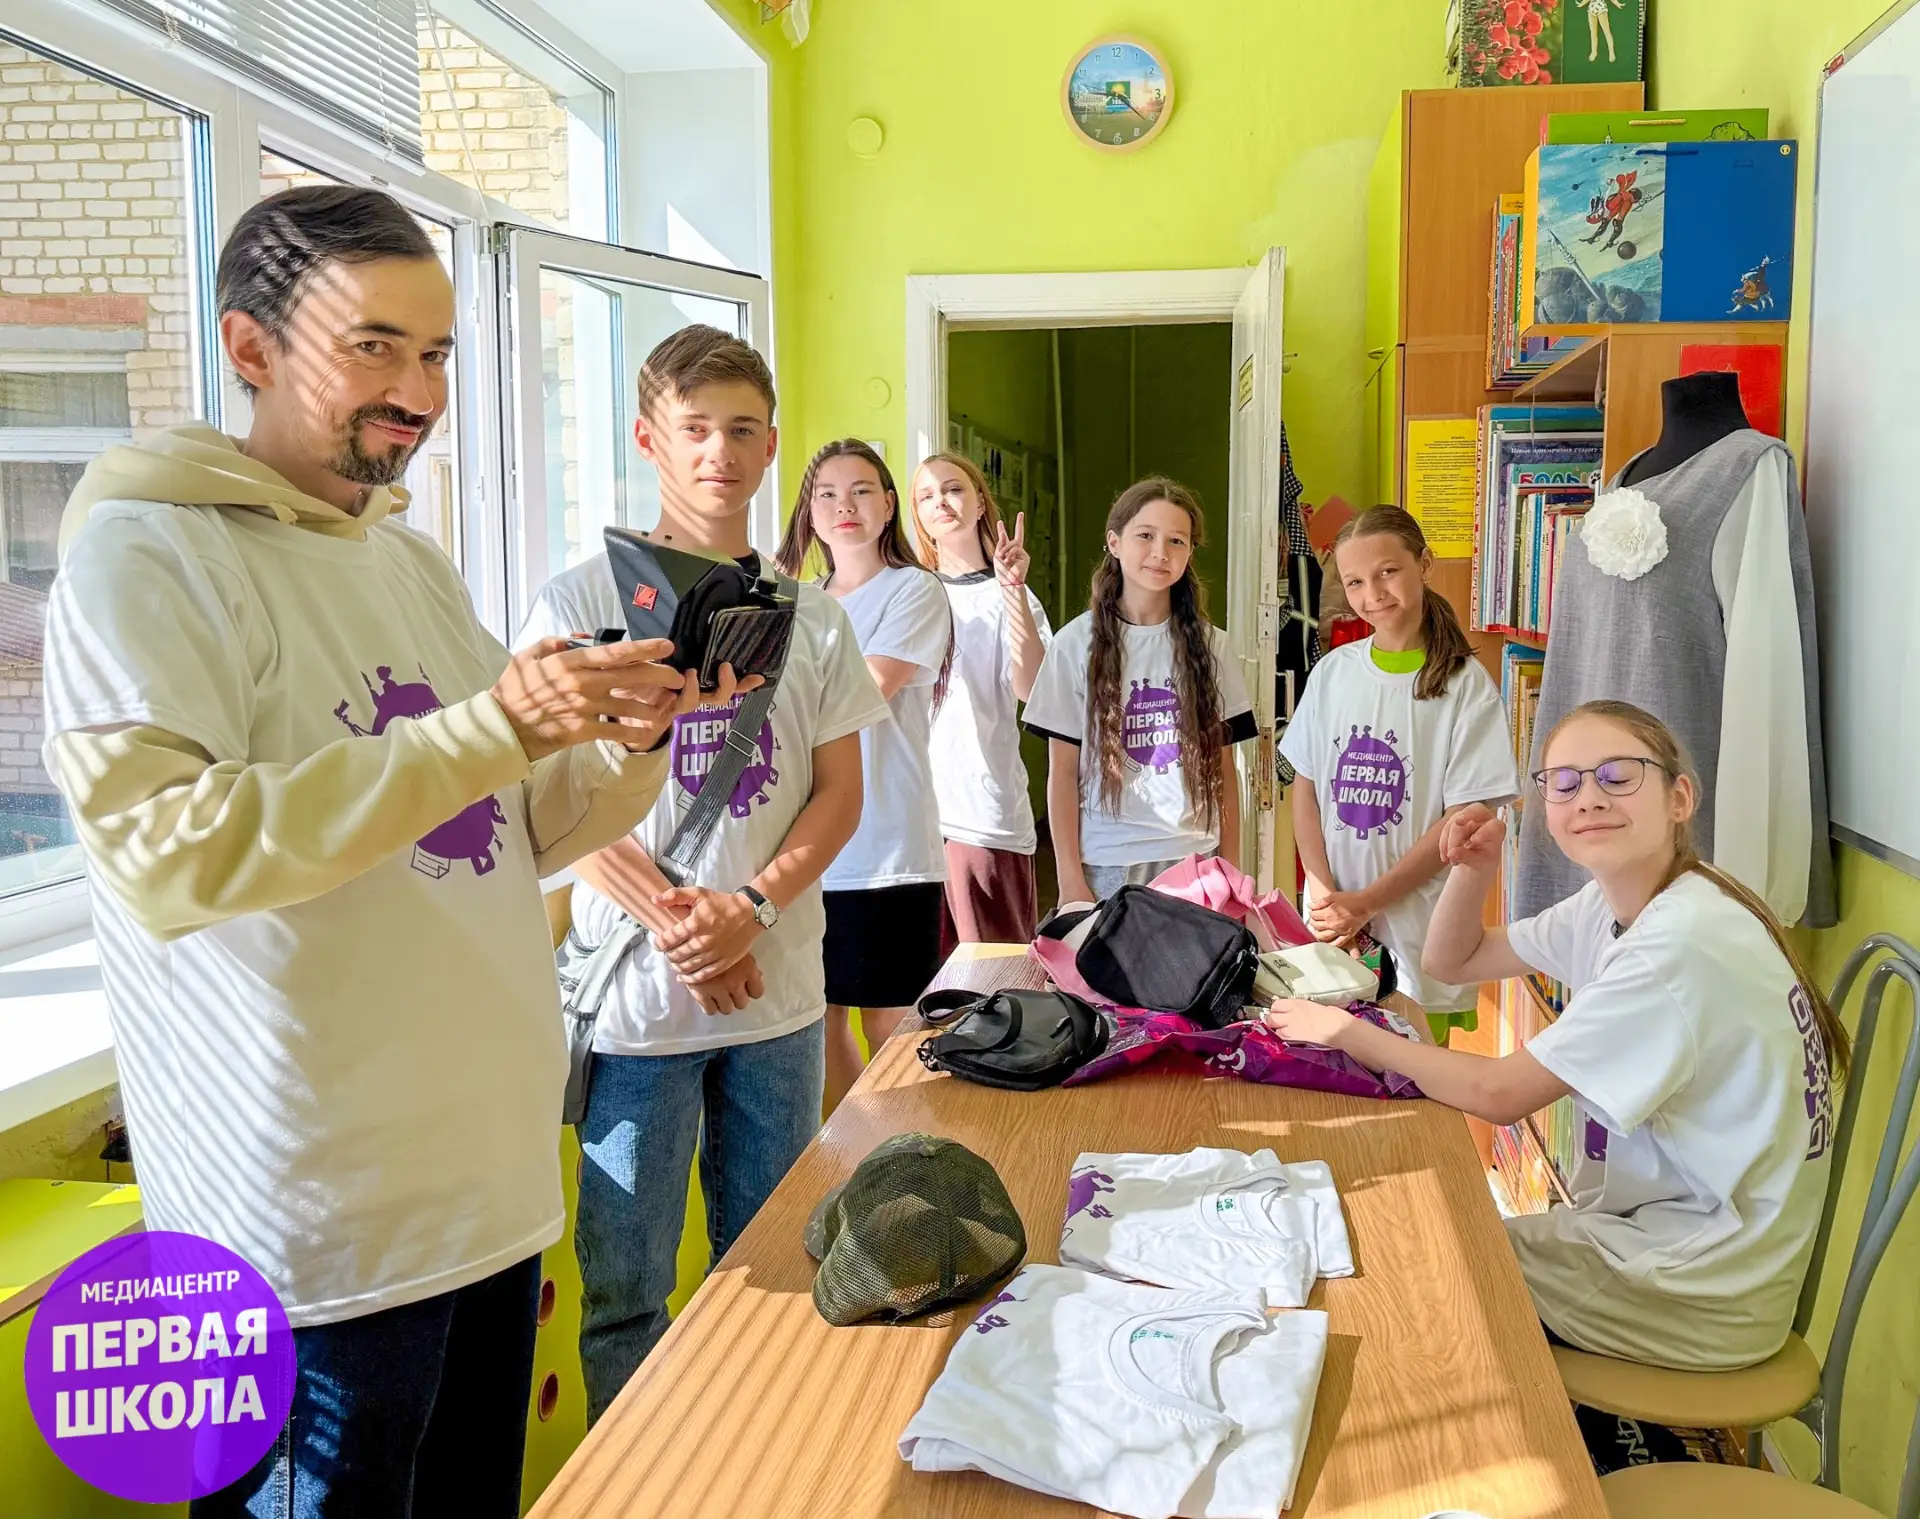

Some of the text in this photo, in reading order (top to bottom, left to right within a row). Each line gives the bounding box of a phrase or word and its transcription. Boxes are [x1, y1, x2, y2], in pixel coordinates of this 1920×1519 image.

[1111, 47, 1121, 58] 12
[1154, 88, 1161, 99] 3
[1133, 698, 1177, 710] МЕДИАЦЕНТР
[1127, 729, 1182, 749] ШКОЛА
[1341, 764, 1401, 787] ПЕРВАЯ
[1338, 786, 1393, 808] ШКОЛА
